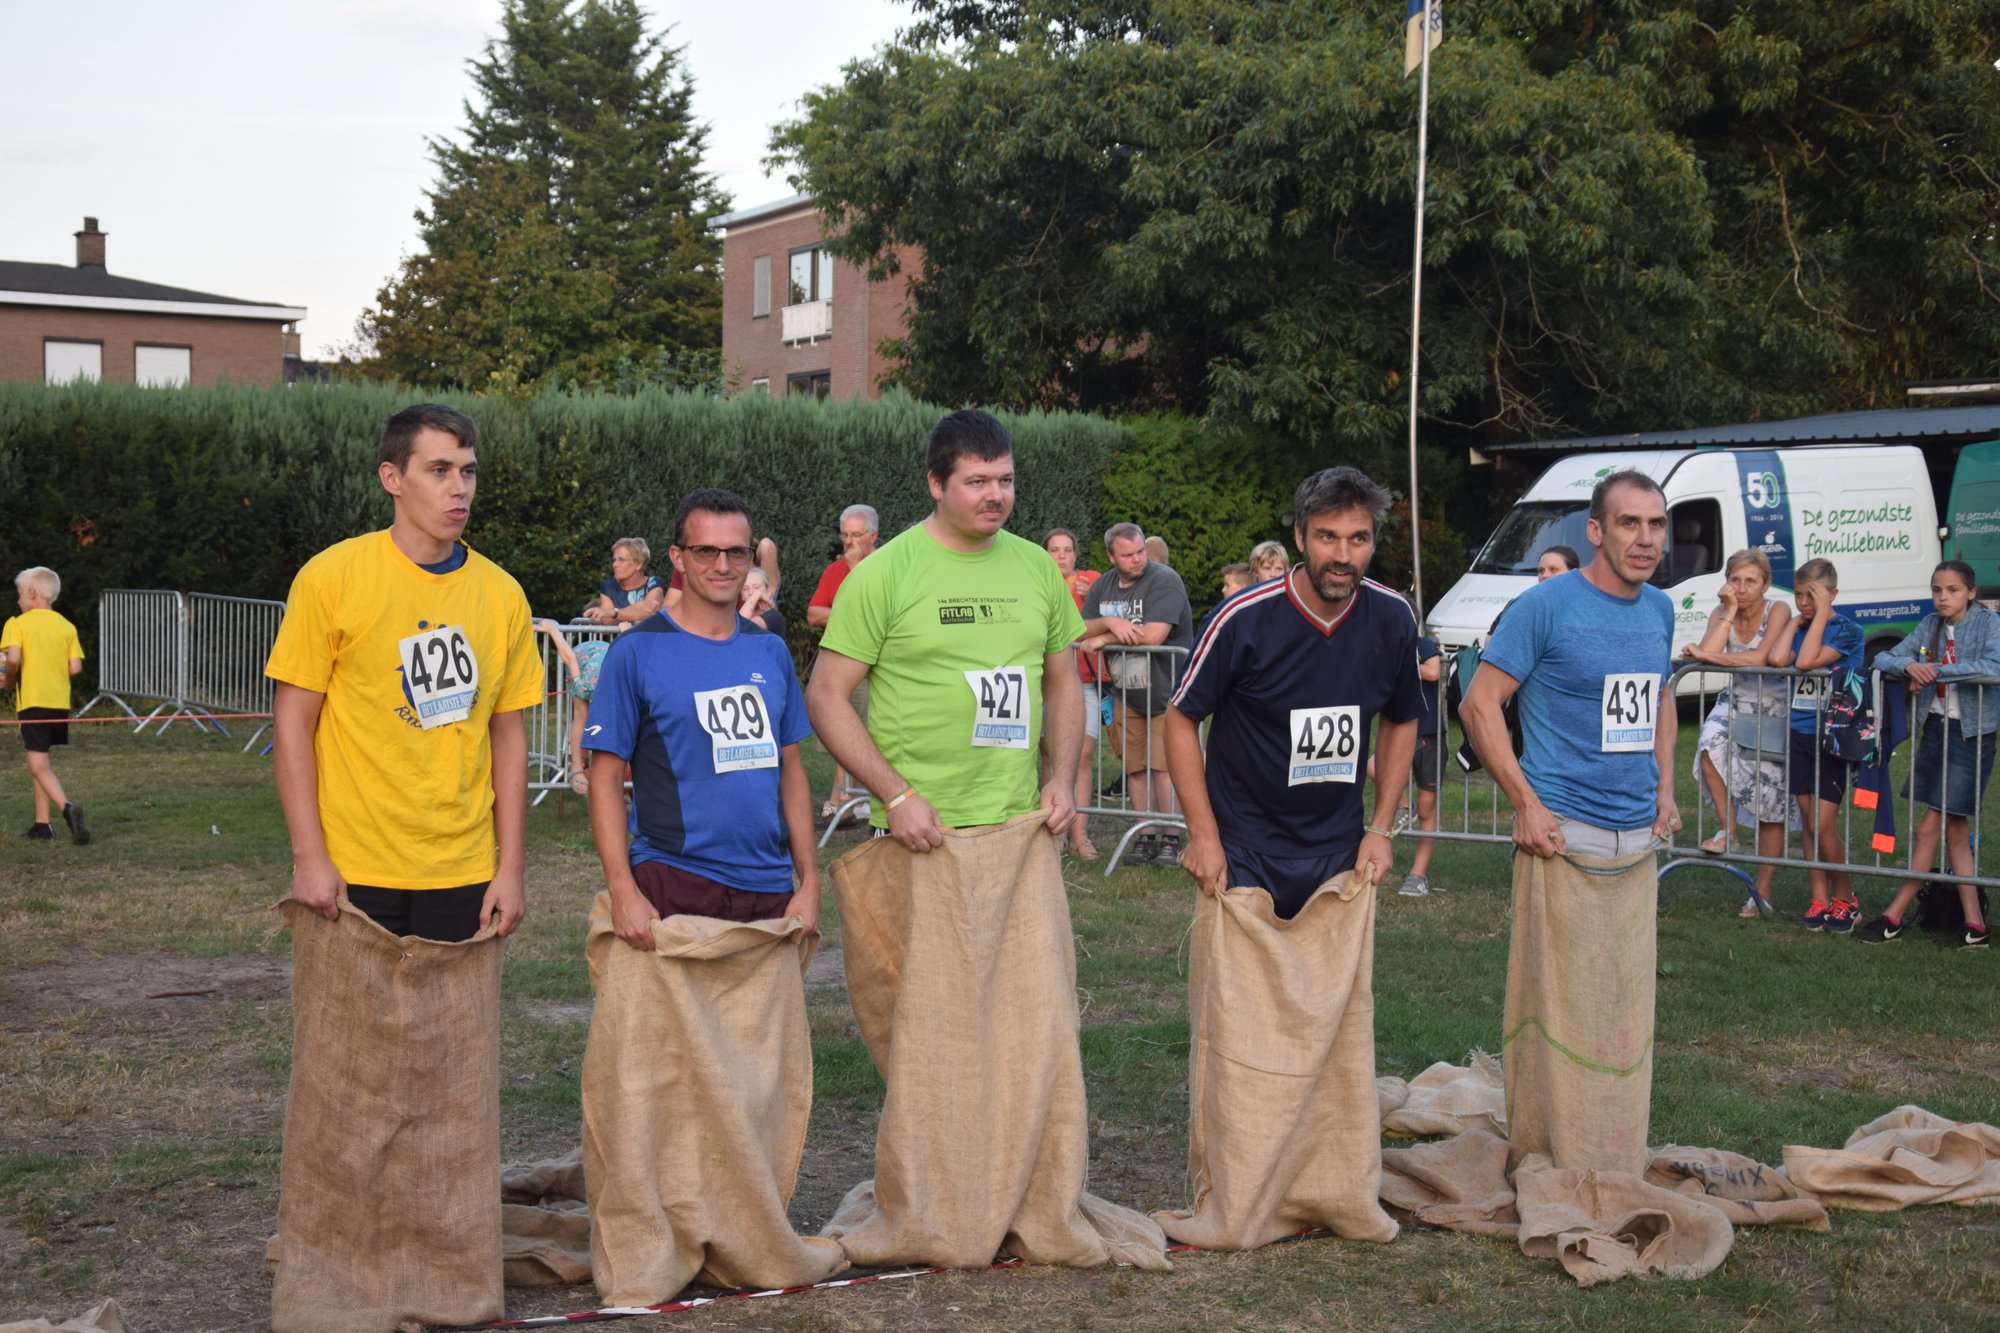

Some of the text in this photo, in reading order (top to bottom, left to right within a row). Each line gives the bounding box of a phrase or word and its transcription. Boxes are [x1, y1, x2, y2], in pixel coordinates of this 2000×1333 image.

[1747, 471, 1780, 509] 50
[1802, 501, 1913, 532] De gezondste
[1805, 530, 1911, 561] familiebank
[941, 607, 974, 618] FITLAB
[1674, 611, 1708, 623] RGENTA
[1855, 604, 1921, 619] www.argenta.be
[411, 632, 473, 694] 426
[981, 672, 1022, 719] 427
[1606, 679, 1651, 724] 431
[708, 692, 764, 740] 429
[1296, 713, 1355, 760] 428
